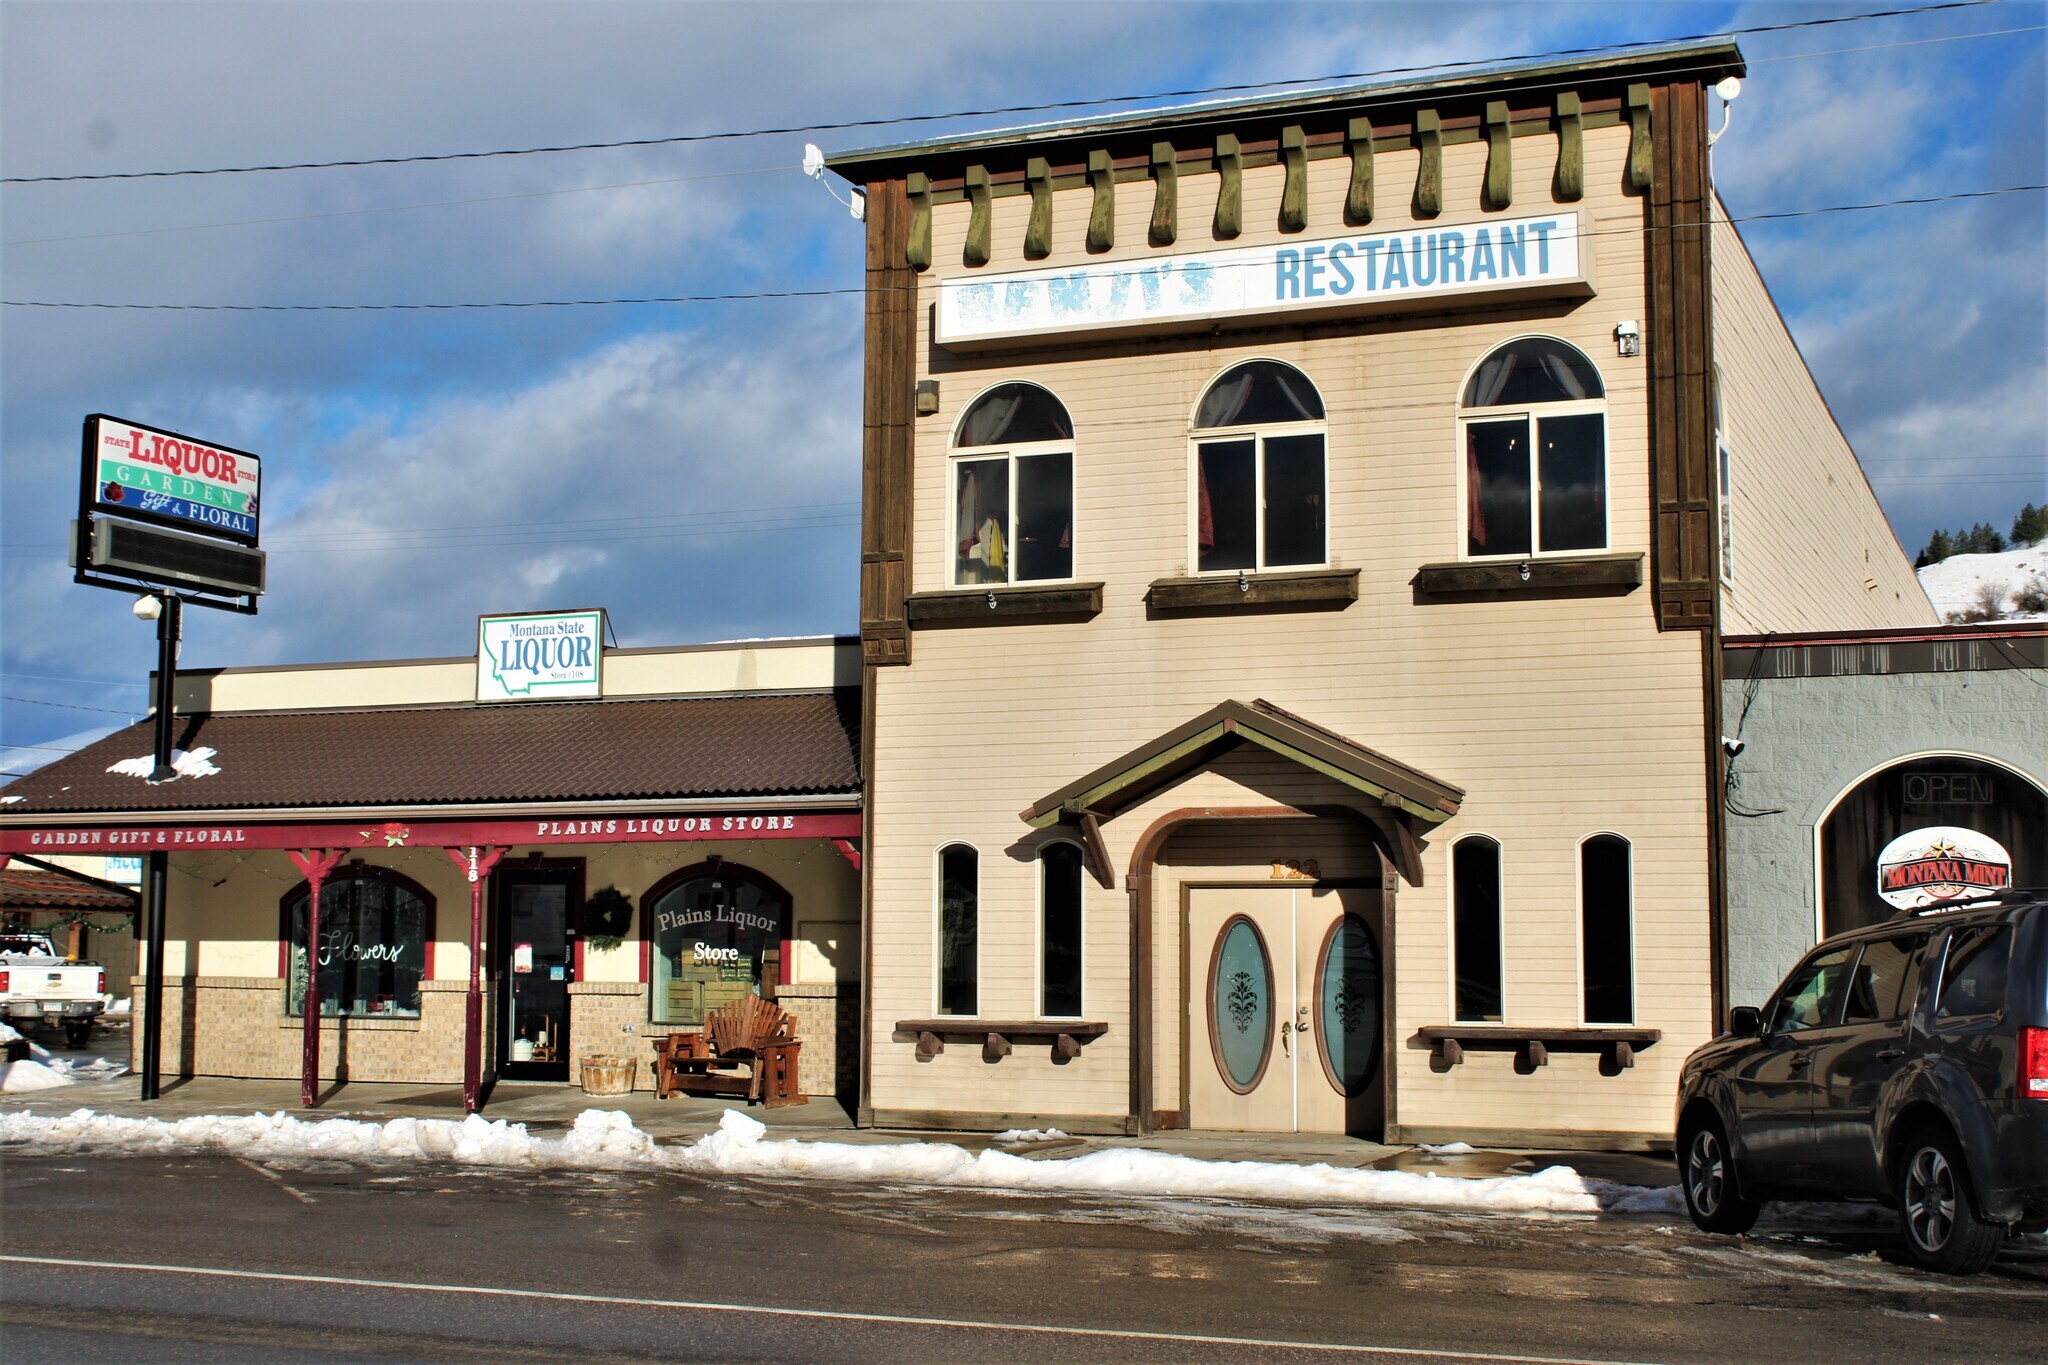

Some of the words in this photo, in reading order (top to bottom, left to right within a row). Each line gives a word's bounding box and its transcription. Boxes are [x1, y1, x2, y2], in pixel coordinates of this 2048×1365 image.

[1276, 221, 1557, 300] RESTAURANT
[104, 436, 130, 449] STATE
[129, 430, 238, 484] LIQUOR
[237, 470, 256, 482] STORE
[117, 466, 232, 505] GARDEN
[140, 489, 173, 511] Gift
[189, 503, 249, 532] FLORAL
[510, 624, 555, 637] Montana
[557, 621, 584, 635] State
[500, 636, 592, 675] LIQUOR
[550, 671, 567, 680] Store
[1907, 775, 1990, 801] OPEN
[31, 832, 101, 845] GARDEN
[109, 831, 151, 844] GIFT
[156, 831, 166, 843] &
[174, 830, 245, 843] FLORAL
[537, 820, 617, 836] PLAINS
[626, 818, 711, 835] LIQUOR
[722, 816, 794, 831] STORE
[1269, 858, 1321, 880] 122
[1887, 860, 1963, 889] MONTANA
[1963, 862, 2007, 887] MINT
[657, 908, 712, 932] Plains
[716, 904, 777, 932] Liquor
[318, 929, 404, 965] Flowers
[694, 941, 739, 961] Store
